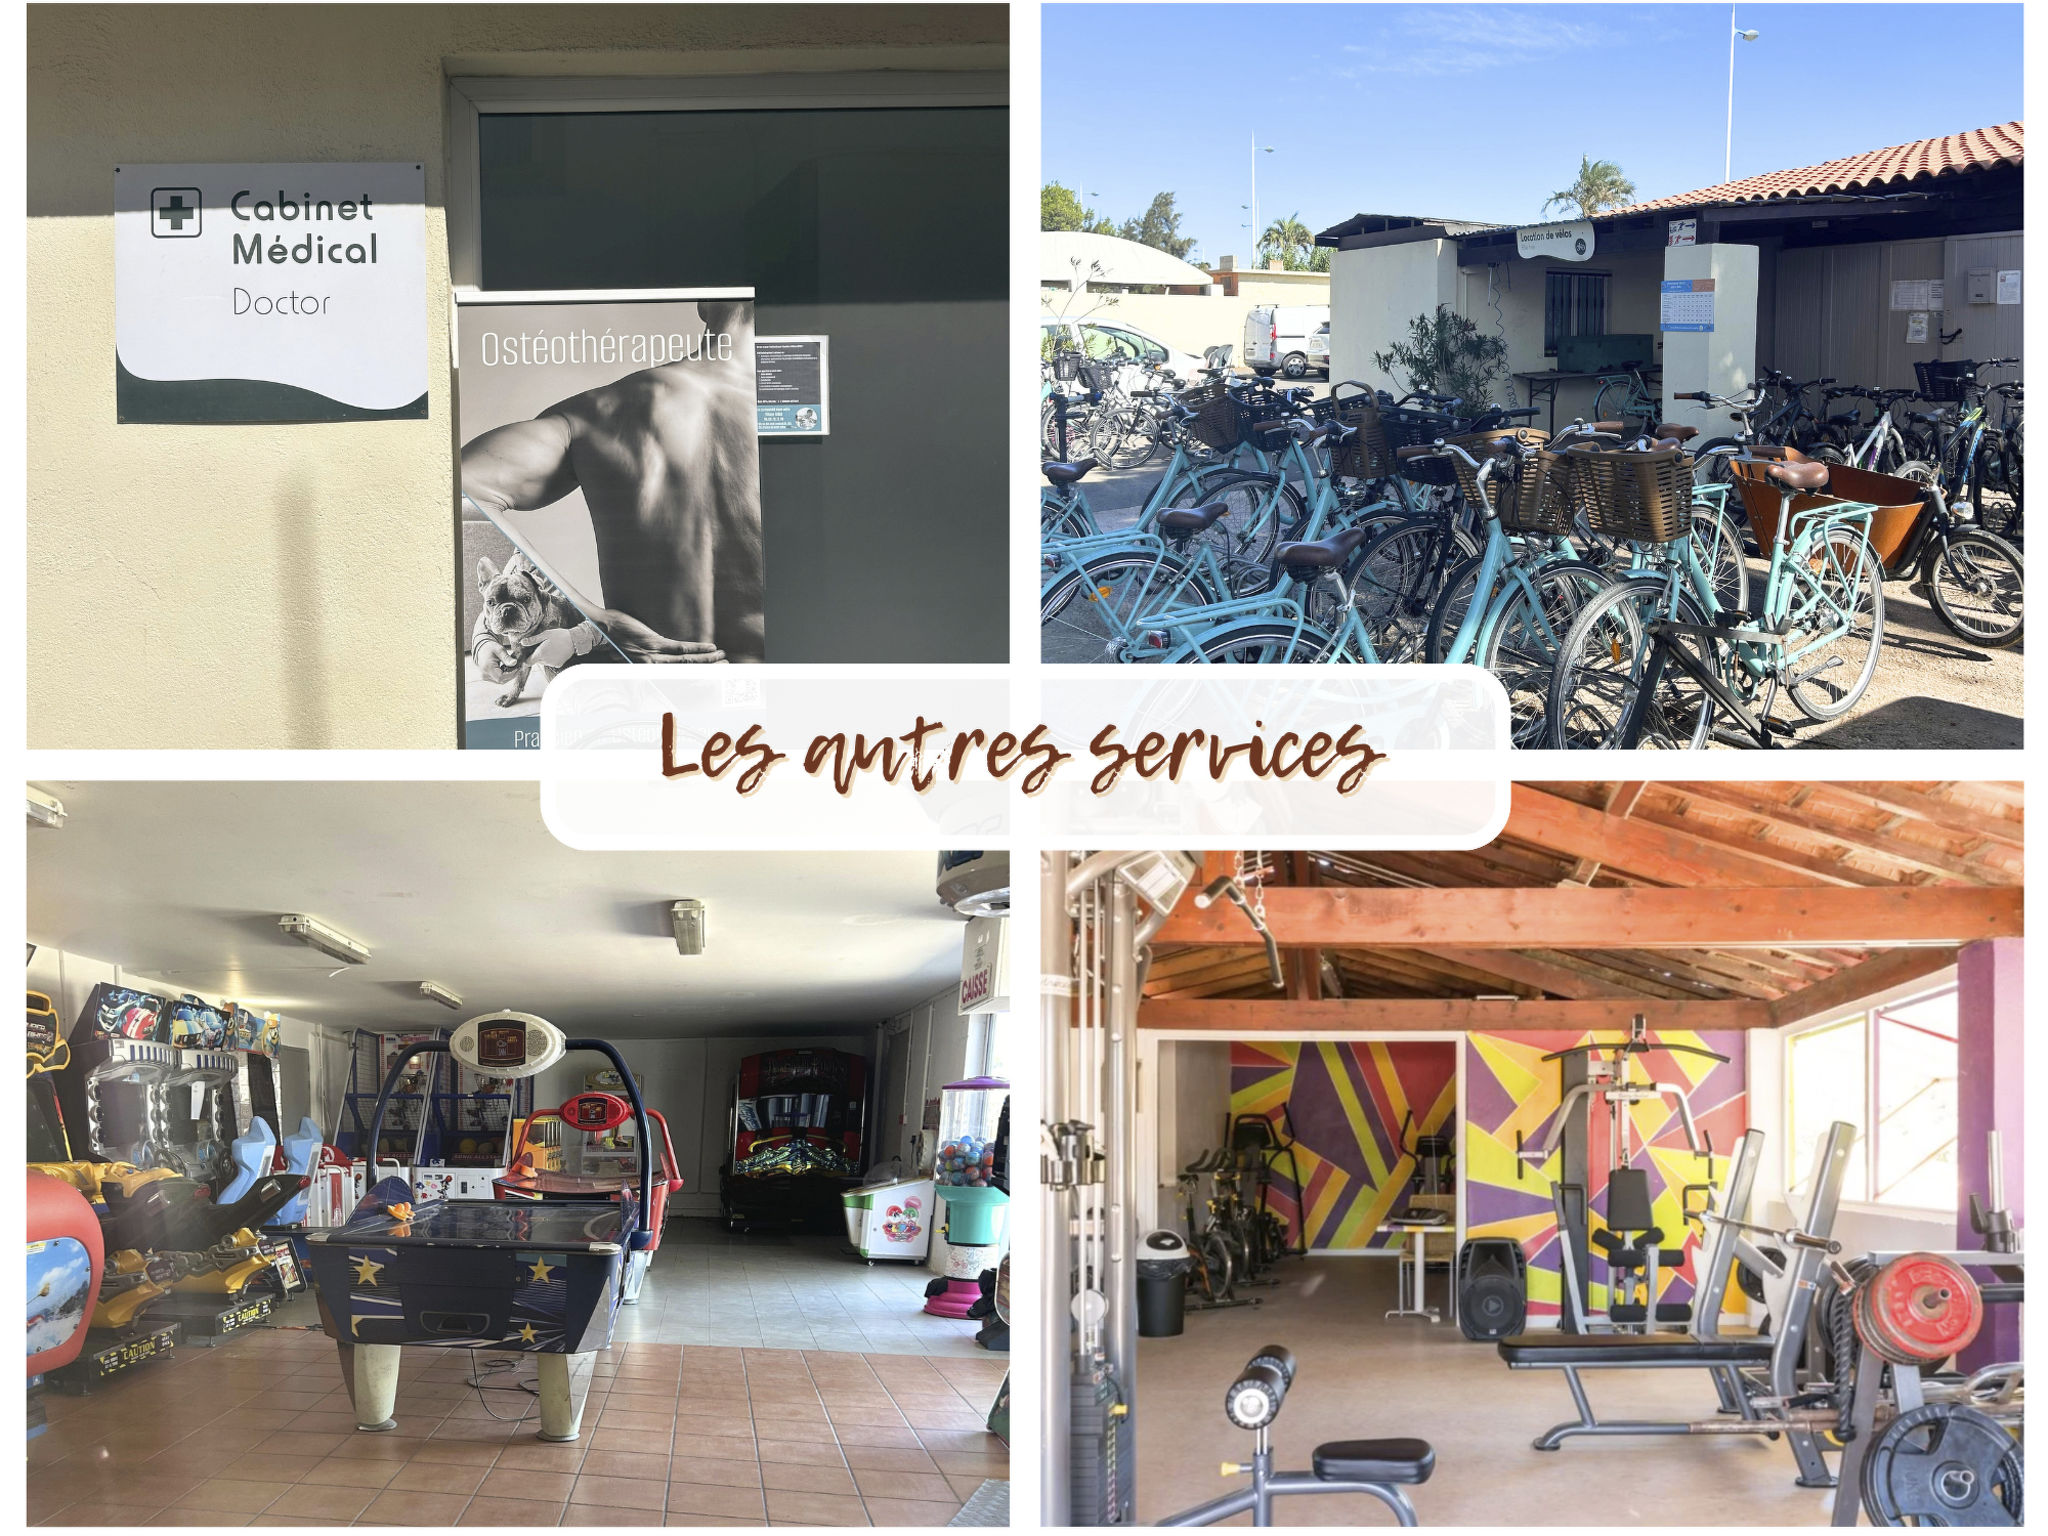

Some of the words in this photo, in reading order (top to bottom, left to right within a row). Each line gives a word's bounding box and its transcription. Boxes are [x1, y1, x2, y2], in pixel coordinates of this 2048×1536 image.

[230, 190, 374, 222] Cabinet
[232, 232, 378, 265] Médical
[1520, 231, 1545, 242] Location
[1546, 229, 1554, 240] de
[232, 287, 331, 316] Doctor
[480, 328, 733, 368] Ostéothérapeute
[962, 969, 988, 1003] CAISSE
[123, 1340, 156, 1360] CAUTION
